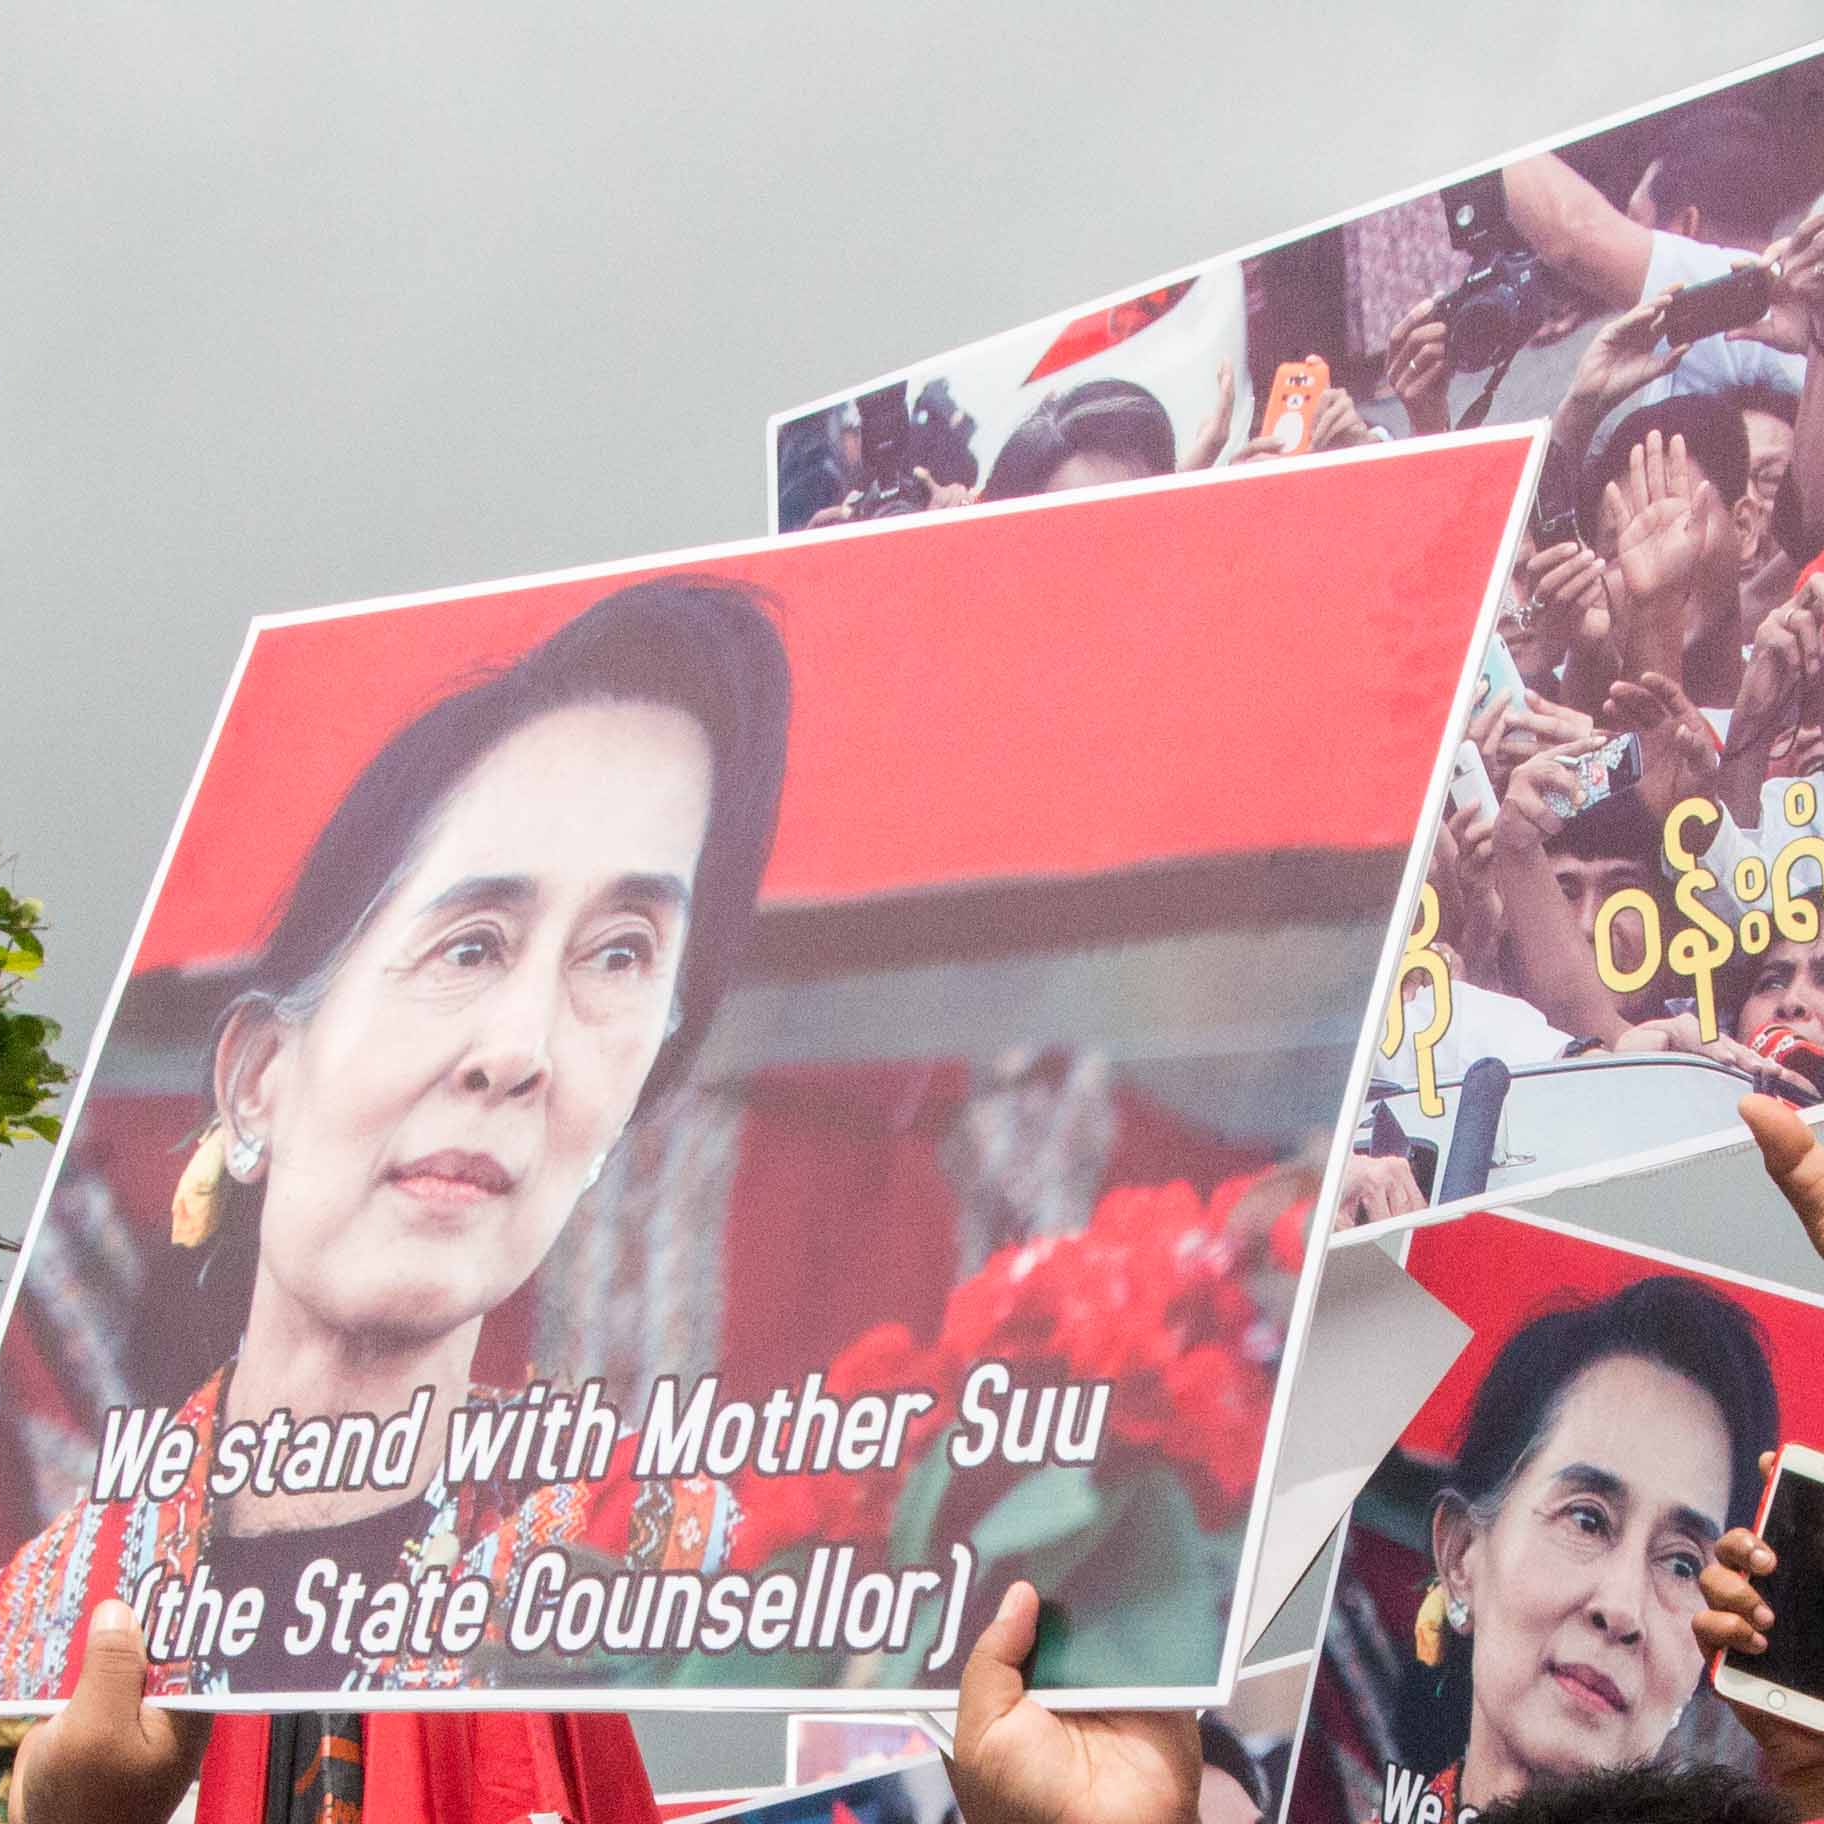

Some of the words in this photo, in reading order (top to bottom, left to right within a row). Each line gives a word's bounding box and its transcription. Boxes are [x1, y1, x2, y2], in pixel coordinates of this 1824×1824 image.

[89, 1405, 200, 1502] We
[210, 1384, 436, 1497] stand
[442, 1378, 621, 1483] with
[635, 1369, 933, 1483] Mother
[951, 1361, 1112, 1470] Suu
[284, 1550, 489, 1659] State
[510, 1540, 981, 1673] Counsellor)
